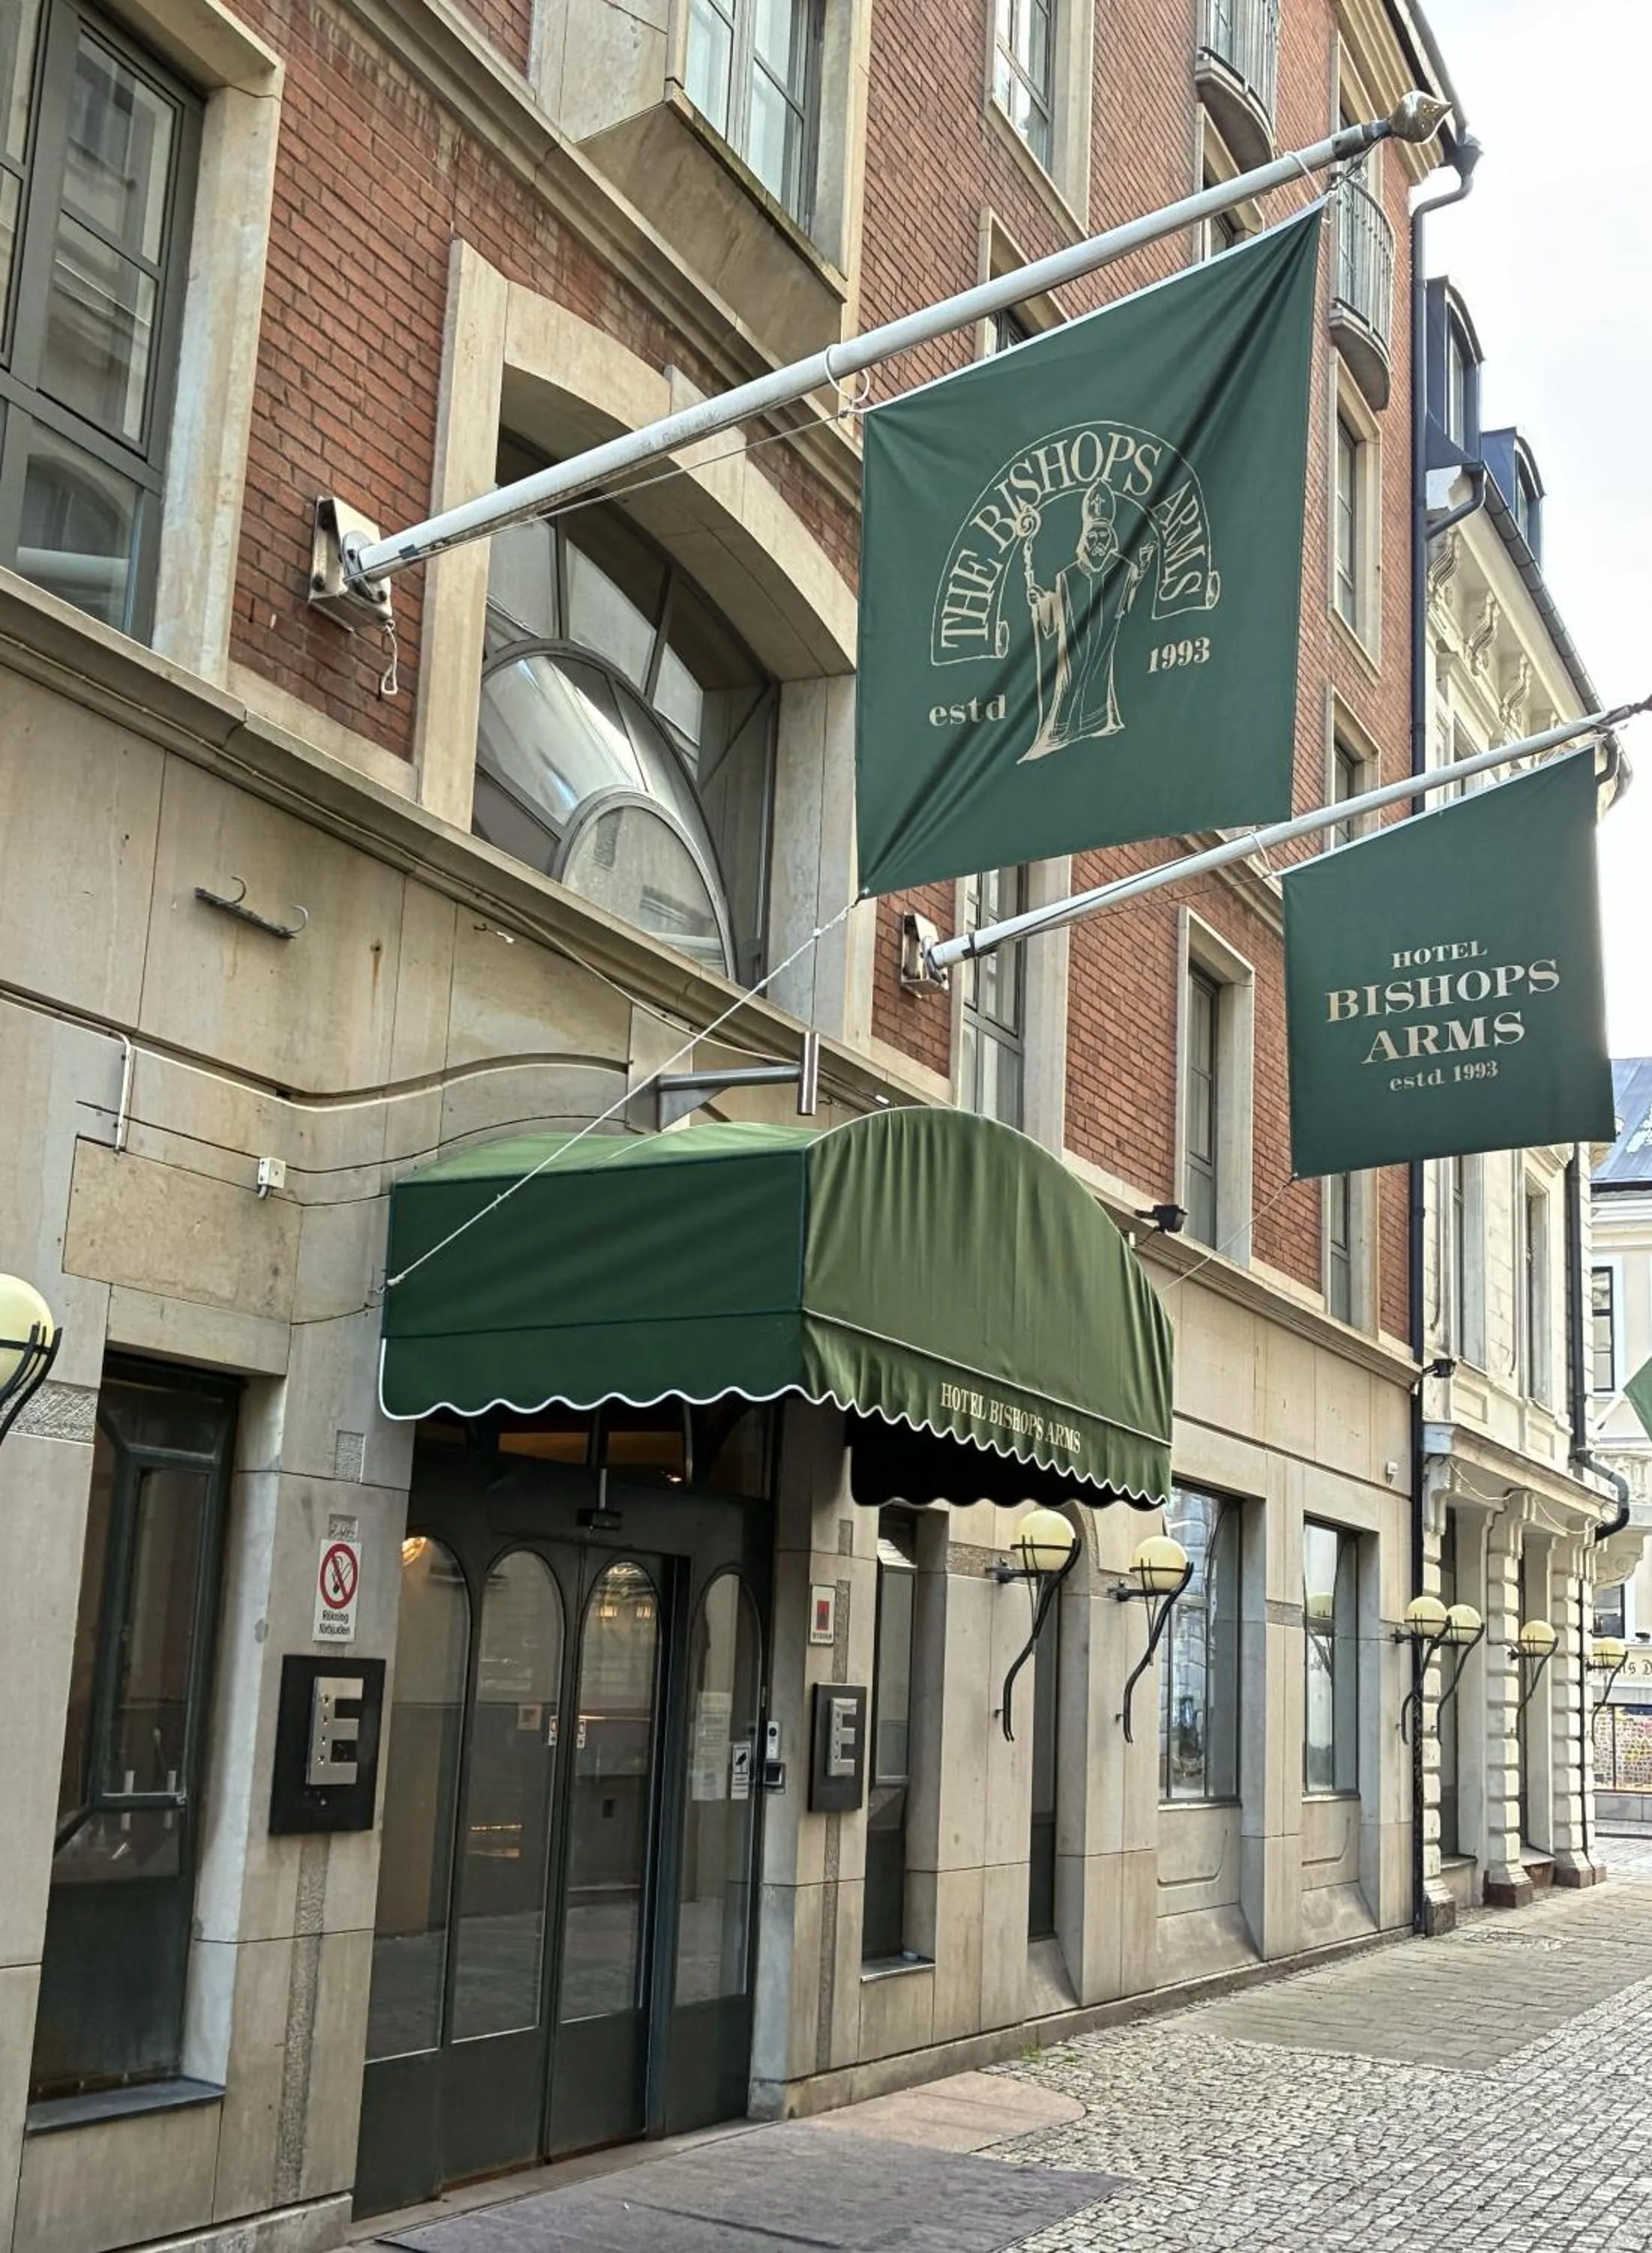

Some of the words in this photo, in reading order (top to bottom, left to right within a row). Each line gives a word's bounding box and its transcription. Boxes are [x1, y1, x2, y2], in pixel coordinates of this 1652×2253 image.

[969, 430, 1162, 553] BISHOPS
[1147, 480, 1206, 601] ARMS
[940, 548, 1004, 649] THE
[1147, 636, 1210, 674] 1993
[928, 694, 1008, 727] estd
[1391, 940, 1488, 970] HOTEL
[1324, 958, 1560, 1023] BISHOPS
[1361, 1011, 1526, 1065] ARMS
[1389, 1067, 1446, 1092] estd
[1453, 1060, 1499, 1083] 1993
[940, 1381, 987, 1421] HOTEL
[989, 1398, 1045, 1442] BISHOPS
[1045, 1420, 1081, 1454] ARMS
